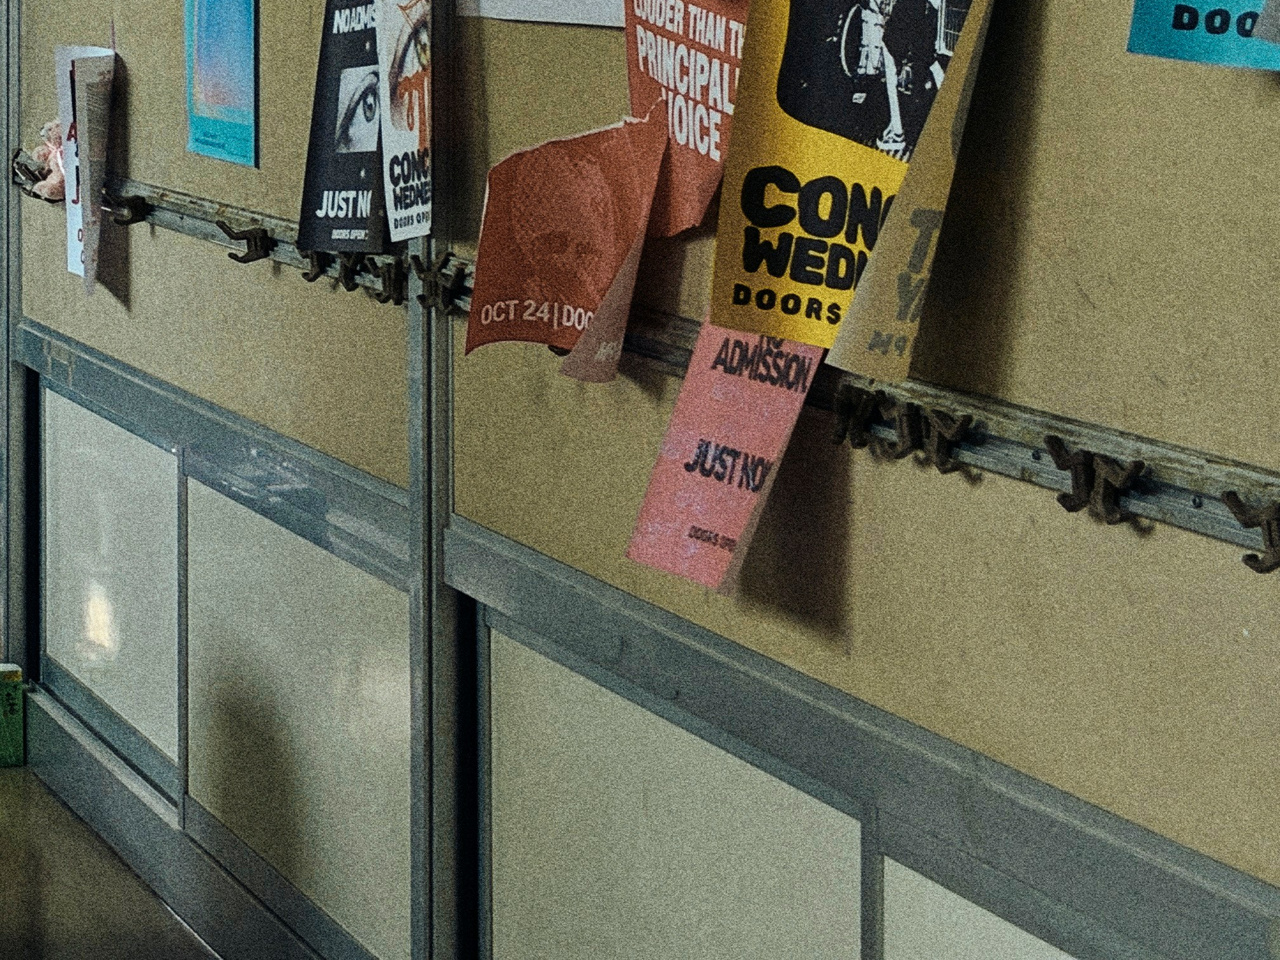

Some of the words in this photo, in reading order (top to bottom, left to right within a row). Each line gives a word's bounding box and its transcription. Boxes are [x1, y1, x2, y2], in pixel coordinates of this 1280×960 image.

[332, 8, 350, 34] NO
[688, 3, 727, 53] THAN
[315, 189, 357, 219] JUST
[394, 214, 414, 230] DOORS
[740, 164, 896, 252] CON
[742, 225, 869, 291] WED
[481, 299, 519, 326] OCT
[523, 299, 550, 322] 24
[732, 283, 842, 325] DOORS
[710, 336, 813, 393] ADMISSION
[683, 438, 742, 486] JUST
